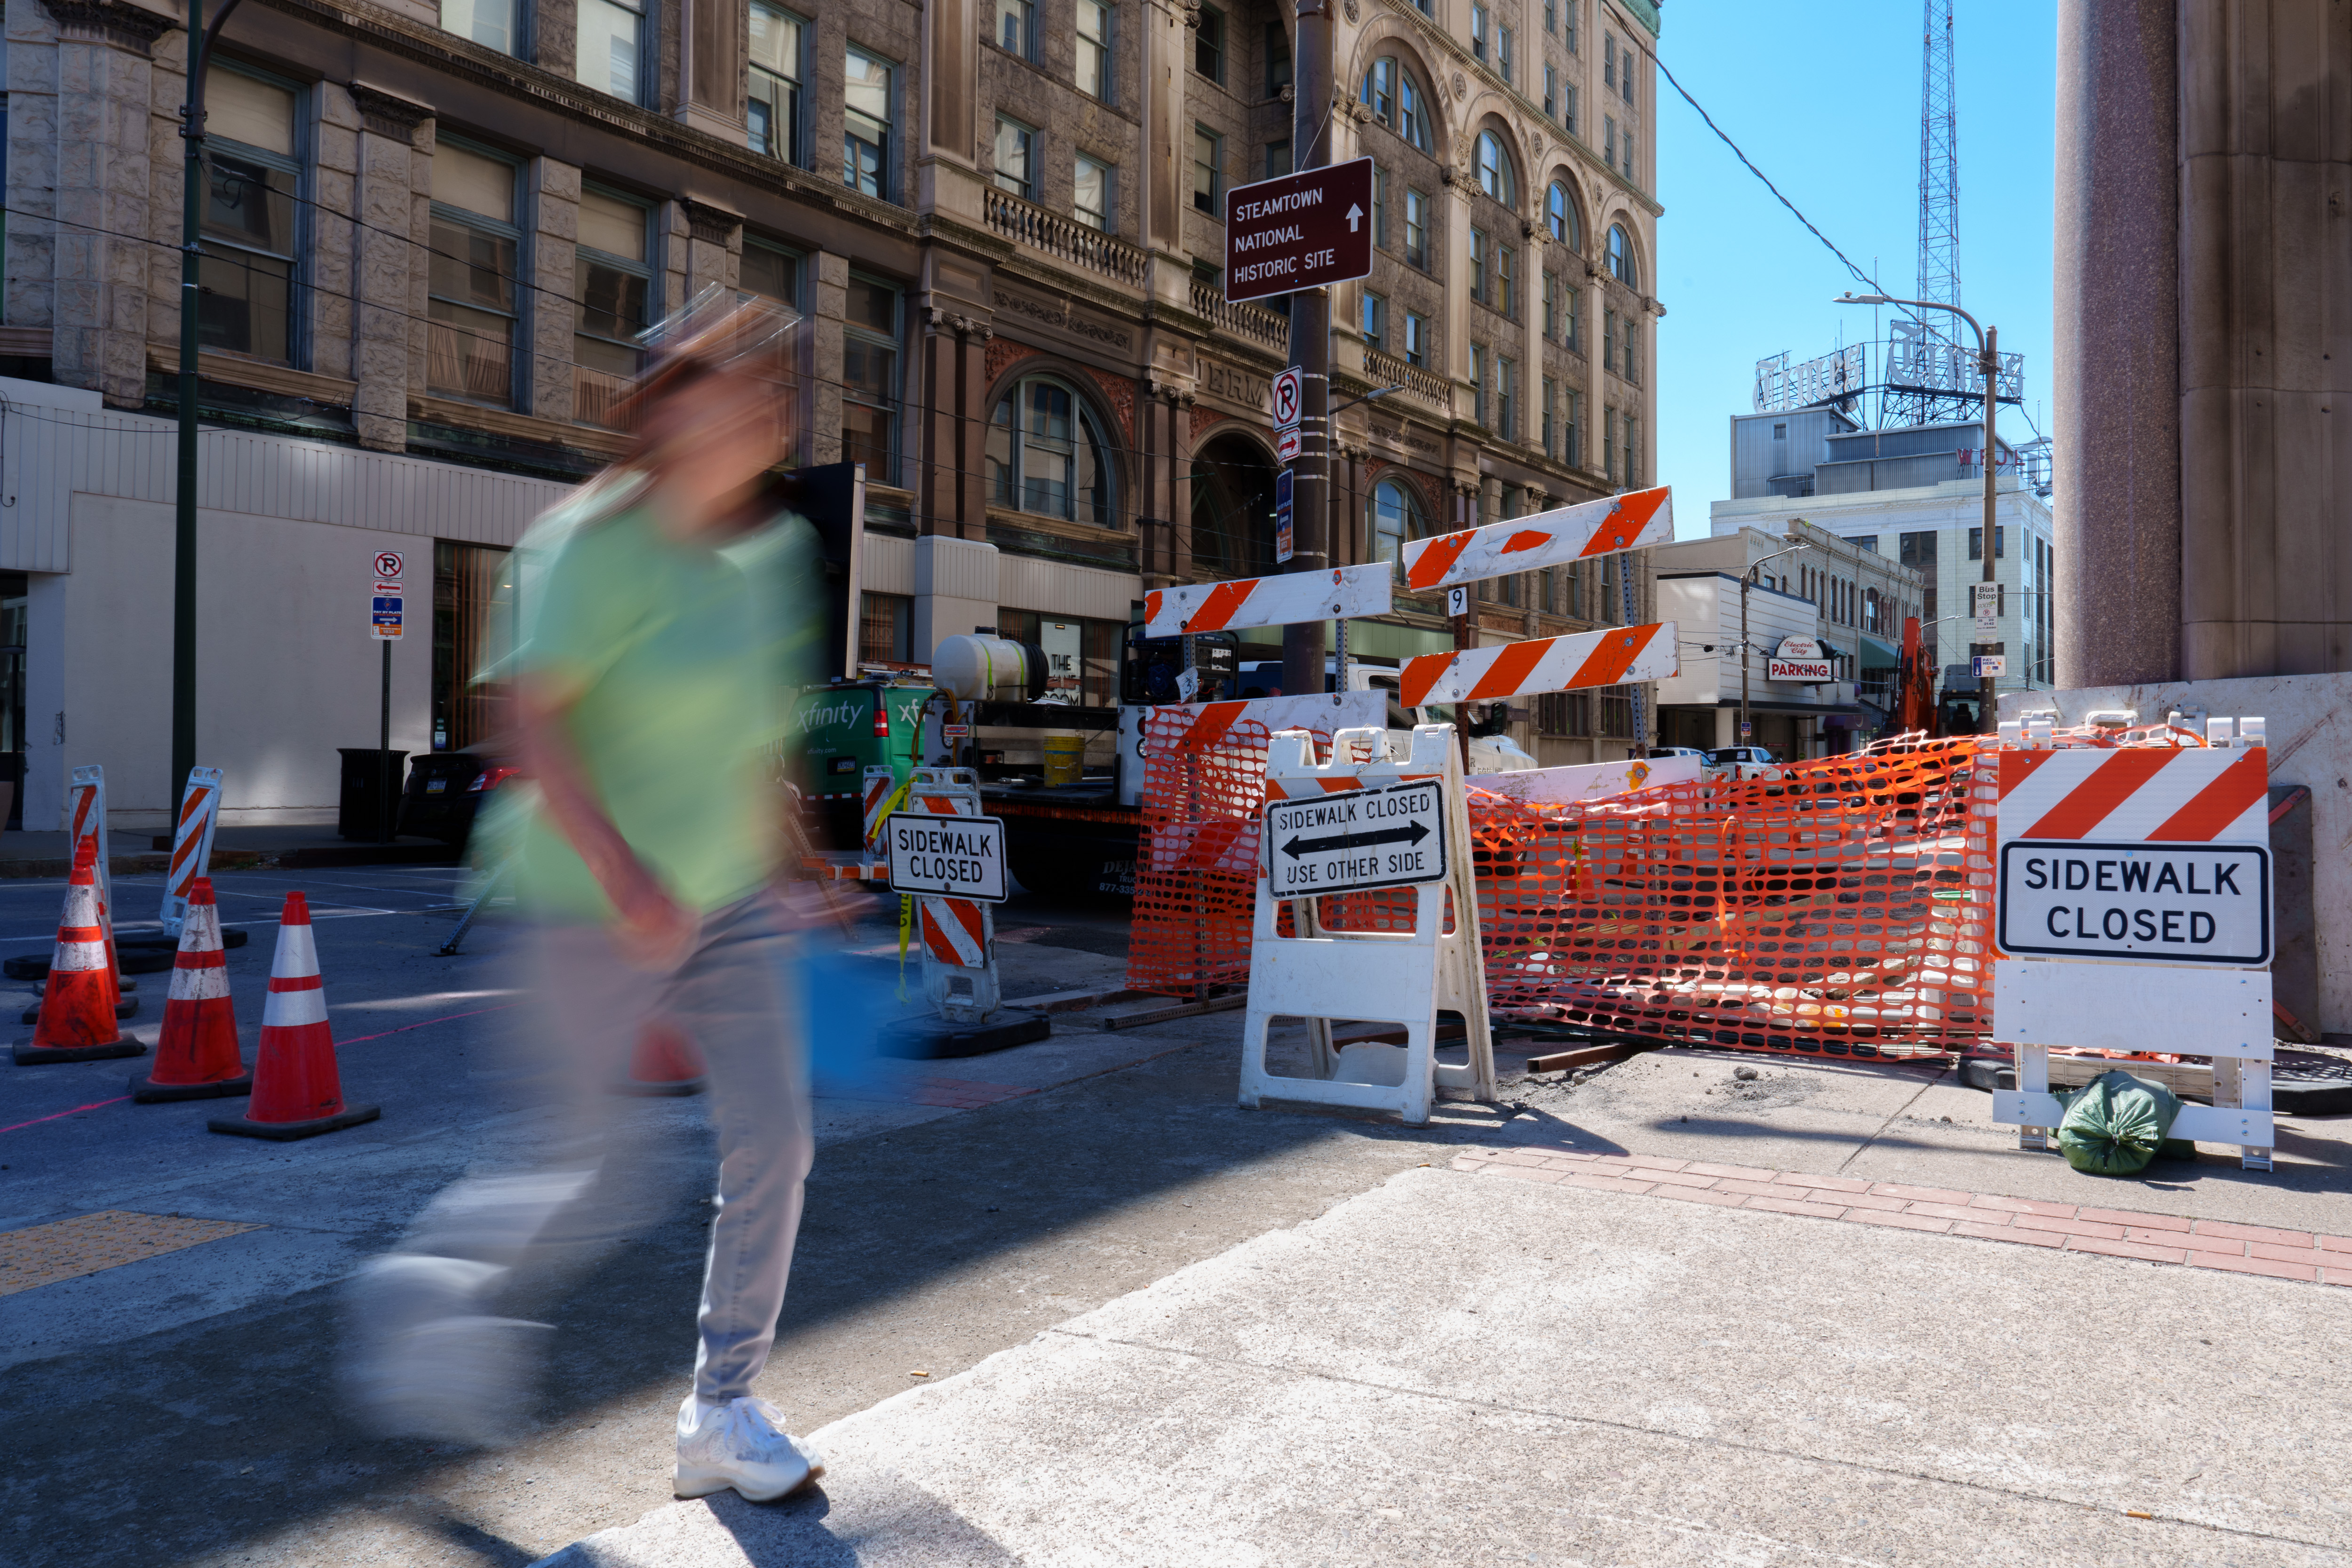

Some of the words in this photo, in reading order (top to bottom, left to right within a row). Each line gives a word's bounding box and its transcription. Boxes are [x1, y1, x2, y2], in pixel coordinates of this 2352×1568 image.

[1236, 188, 1322, 222] STEAMTOWN
[1235, 224, 1304, 253] NATIONAL
[1235, 256, 1297, 284] HISTORIC
[1304, 248, 1335, 270] SITE
[1195, 358, 1273, 407] JERM
[1753, 343, 1860, 414] Times
[1453, 589, 1462, 609] 9
[1052, 654, 1071, 670] THE
[1772, 664, 1828, 677] PARKING
[796, 700, 864, 733] xfinity
[1060, 807, 1088, 821] SUDDEN
[1091, 809, 1113, 824] STOPS
[1116, 812, 1130, 824] AND
[1279, 804, 1357, 830] SIDEWALK
[1367, 794, 1430, 819] CLOSED
[898, 829, 992, 858] SIDEWALK
[910, 855, 983, 883] CLOSED
[1102, 860, 1151, 875] DEJAN
[1287, 864, 1318, 883] USE
[1327, 857, 1379, 880] OTHER
[1388, 852, 1424, 874] SIDE
[2025, 859, 2241, 896] SIDEWALK
[2047, 906, 2216, 944] CLOSED
